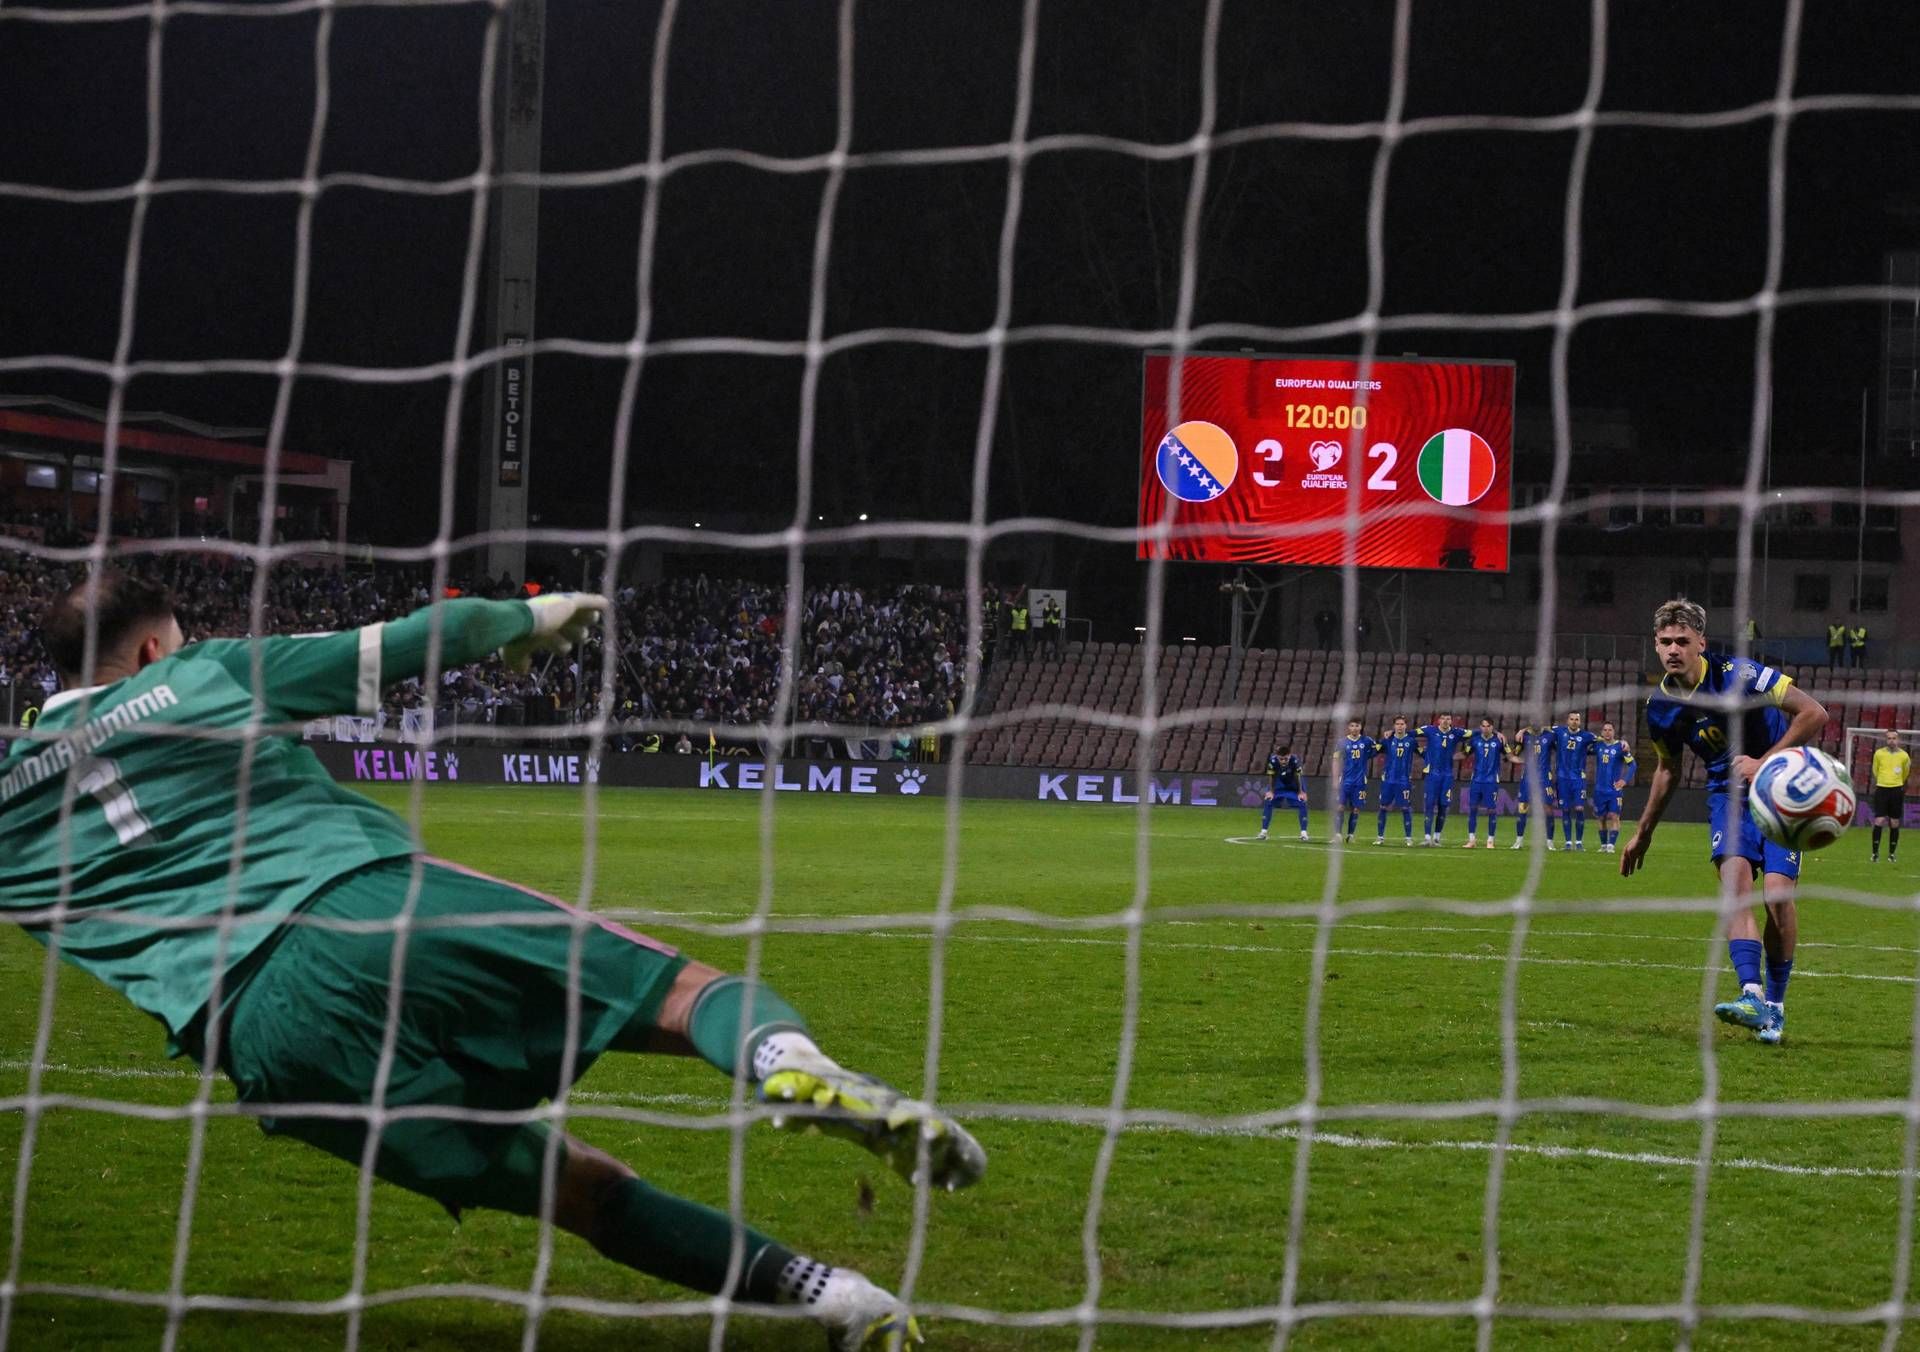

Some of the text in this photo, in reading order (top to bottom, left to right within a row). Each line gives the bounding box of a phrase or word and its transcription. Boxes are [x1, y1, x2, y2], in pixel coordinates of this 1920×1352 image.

[1275, 378, 1382, 391] EUROPEAN QUALIFIERS
[506, 368, 520, 452] BETOLE
[1285, 404, 1367, 430] 120:00
[1253, 439, 1283, 487] 3
[1367, 442, 1398, 491] 2
[1301, 480, 1348, 489] QUALIFIERS
[353, 750, 439, 780] KELME
[1351, 749, 1361, 759] 20
[1396, 748, 1405, 758] 17
[503, 755, 580, 783] KELME
[699, 761, 879, 793] KELME
[77, 758, 153, 846] 1
[1038, 774, 1219, 806] KELME
